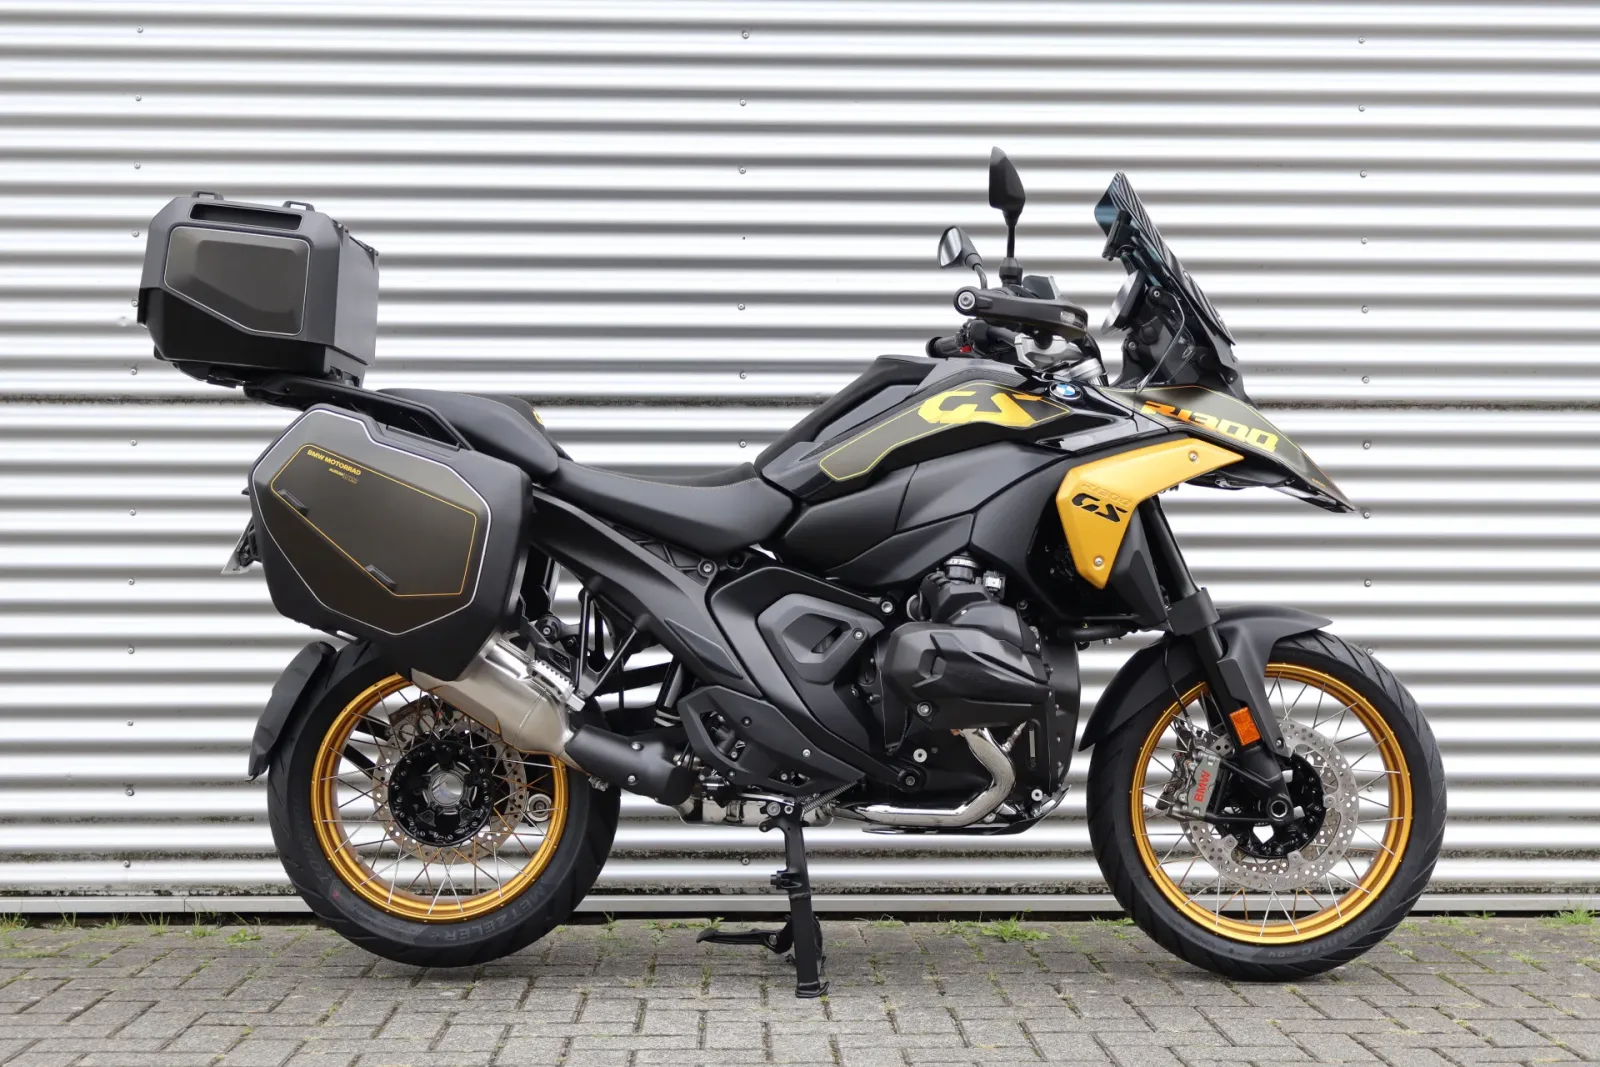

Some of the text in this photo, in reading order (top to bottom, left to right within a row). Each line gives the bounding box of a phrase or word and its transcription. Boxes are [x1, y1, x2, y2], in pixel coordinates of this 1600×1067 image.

[1140, 400, 1279, 453] R1300
[306, 449, 325, 461] BMW
[324, 456, 361, 476] MOTORRAD
[1071, 492, 1128, 522] GS
[1193, 770, 1211, 802] BMW
[443, 884, 549, 940] METZELER
